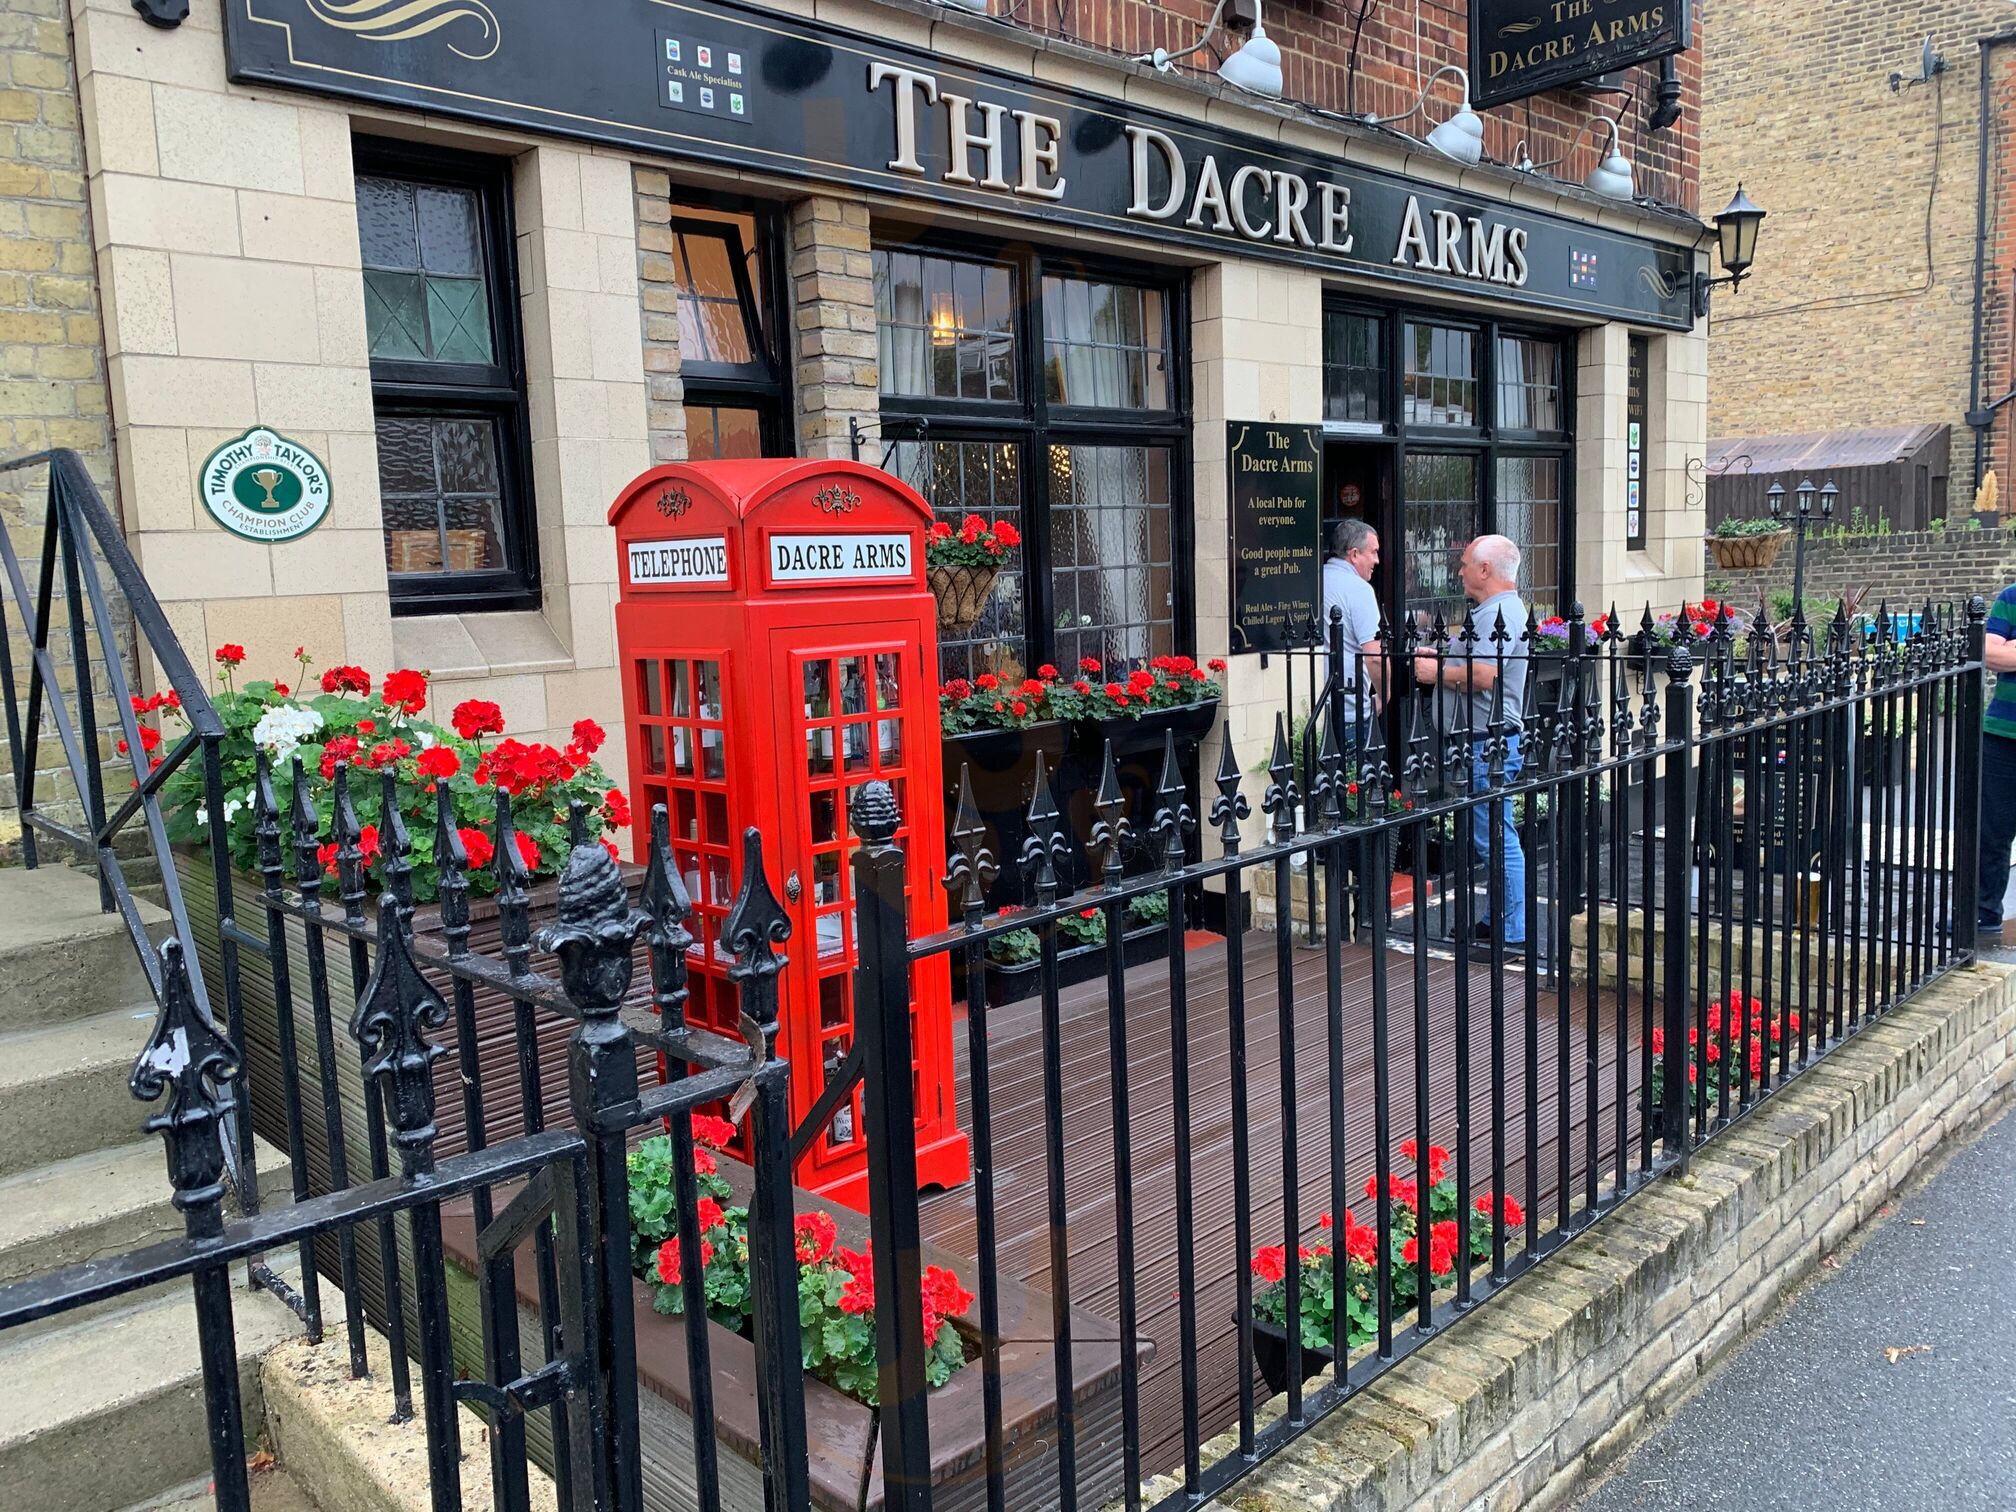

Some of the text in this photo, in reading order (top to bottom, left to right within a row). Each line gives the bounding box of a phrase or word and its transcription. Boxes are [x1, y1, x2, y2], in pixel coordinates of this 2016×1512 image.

[1551, 0, 1594, 23] THE
[1488, 6, 1664, 79] DACRE ARMS
[667, 65, 743, 89] Cask Ale Specialists
[870, 61, 1529, 287] THE DACRE ARMS
[1628, 366, 1641, 378] cre
[1266, 431, 1290, 449] The
[211, 444, 323, 496] TIMOTHY TAYLOR'S
[1242, 454, 1313, 473] Dacre Arms
[1248, 497, 1307, 509] A local Pub for
[222, 500, 315, 528] CHAMPION CLUB
[1258, 515, 1296, 527] everyone.
[239, 521, 304, 536] ESTABLISHMENT
[631, 545, 727, 579] TELEPHONE
[777, 543, 907, 571] DACRE ARMS
[1241, 546, 1313, 561] Good people make
[1254, 562, 1301, 578] a great Pub.
[1245, 603, 1260, 613] Real
[1260, 602, 1273, 612] Ales
[1278, 601, 1291, 611] Fine
[1292, 600, 1310, 609] Wines
[1242, 615, 1264, 626] Chilled
[1293, 611, 1310, 623] Spirit
